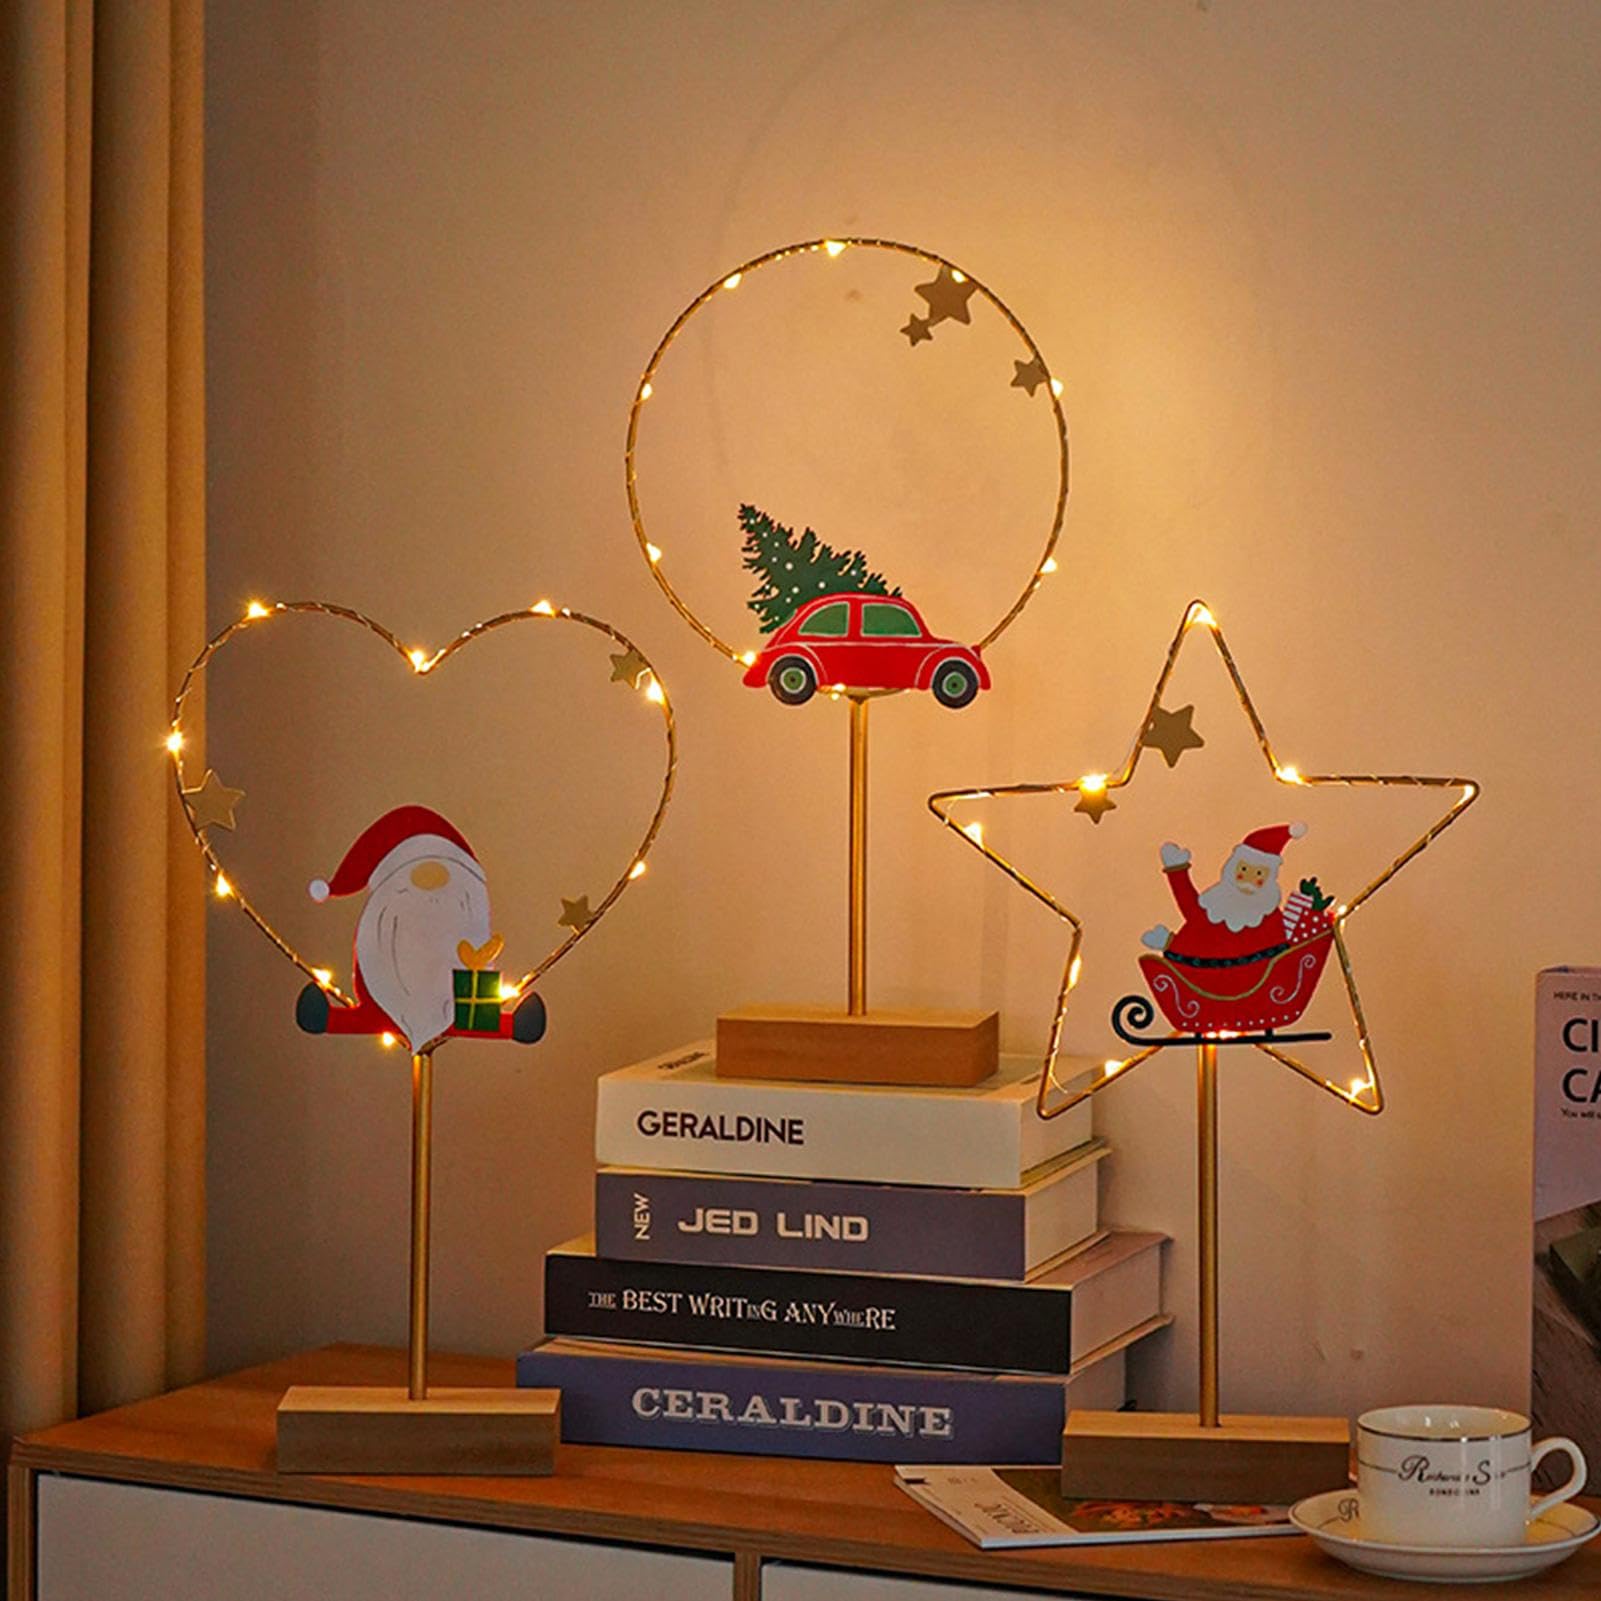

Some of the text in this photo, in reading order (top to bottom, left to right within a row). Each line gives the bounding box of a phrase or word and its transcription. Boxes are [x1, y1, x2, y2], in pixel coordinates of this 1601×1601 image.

[637, 1110, 804, 1145] GERALDINE
[634, 1193, 650, 1240] NEW
[677, 1207, 869, 1242] JED LIND
[588, 1291, 616, 1308] THE
[622, 1288, 683, 1314] BEST
[631, 1386, 954, 1438] CERALDINE
